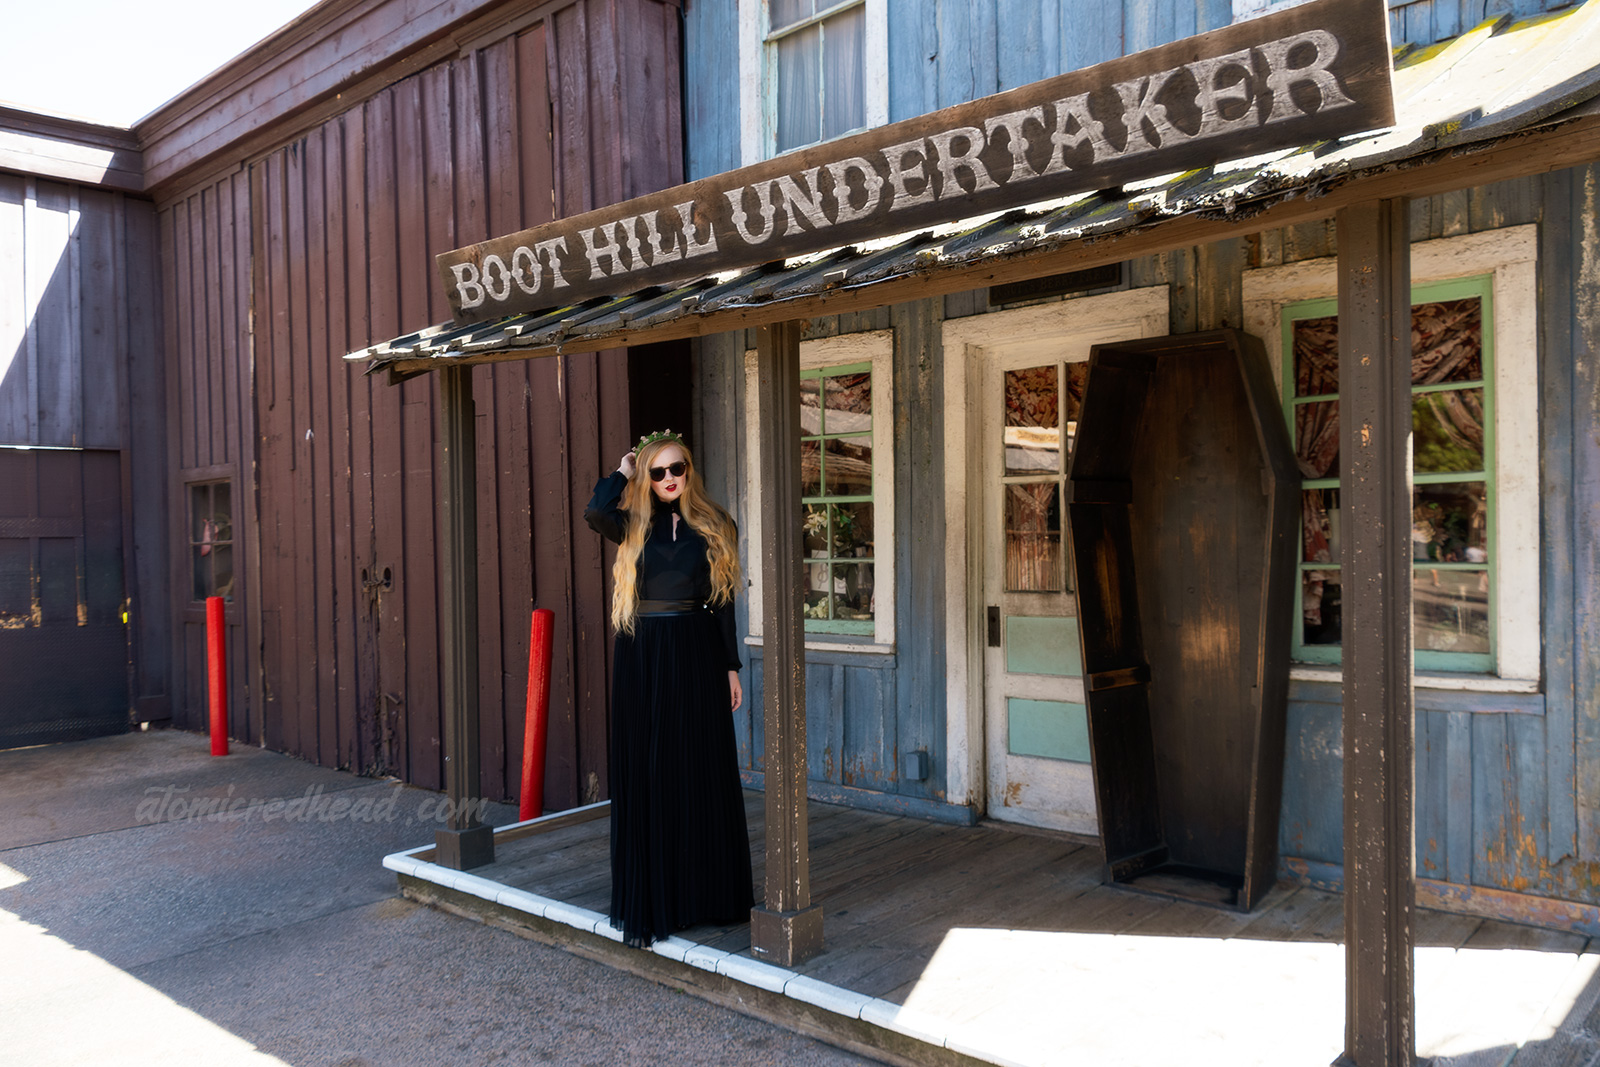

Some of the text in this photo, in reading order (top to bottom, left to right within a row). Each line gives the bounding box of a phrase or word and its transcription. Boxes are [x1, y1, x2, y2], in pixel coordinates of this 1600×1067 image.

[450, 28, 1356, 310] BOOT HILL UNDERTAKER
